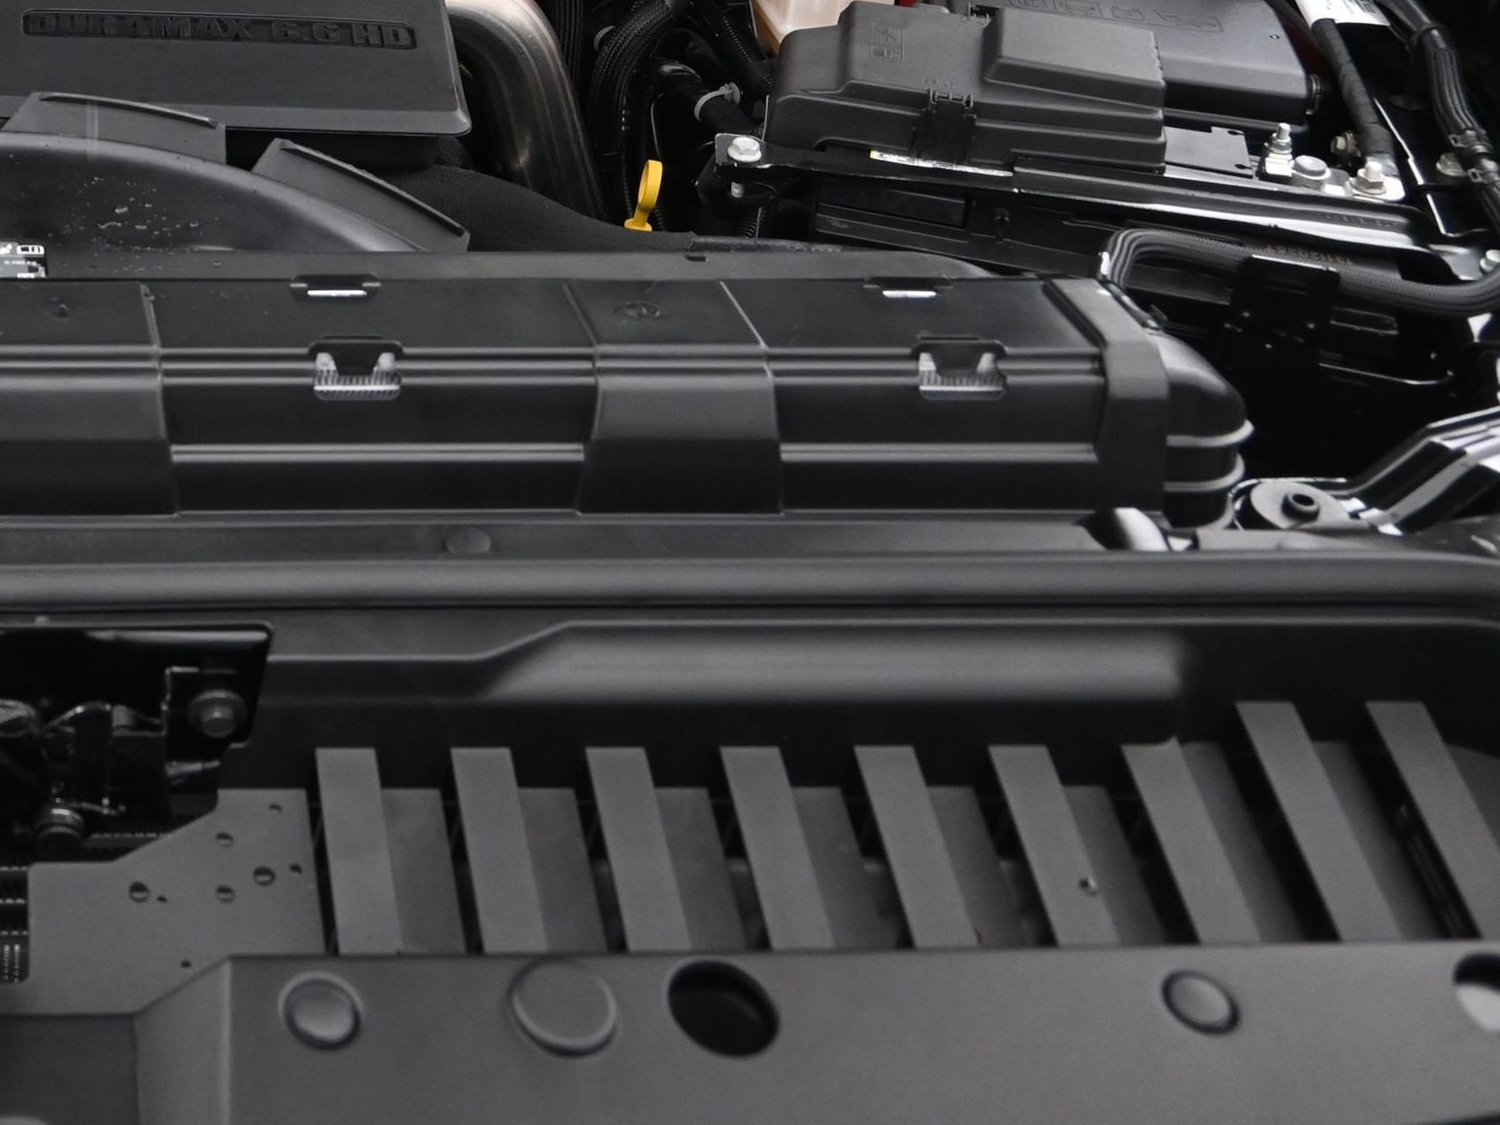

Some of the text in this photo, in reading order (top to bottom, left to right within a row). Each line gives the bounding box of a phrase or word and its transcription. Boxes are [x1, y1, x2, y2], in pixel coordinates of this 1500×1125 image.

[30, 13, 412, 50] DURAMAX 6.6 HD
